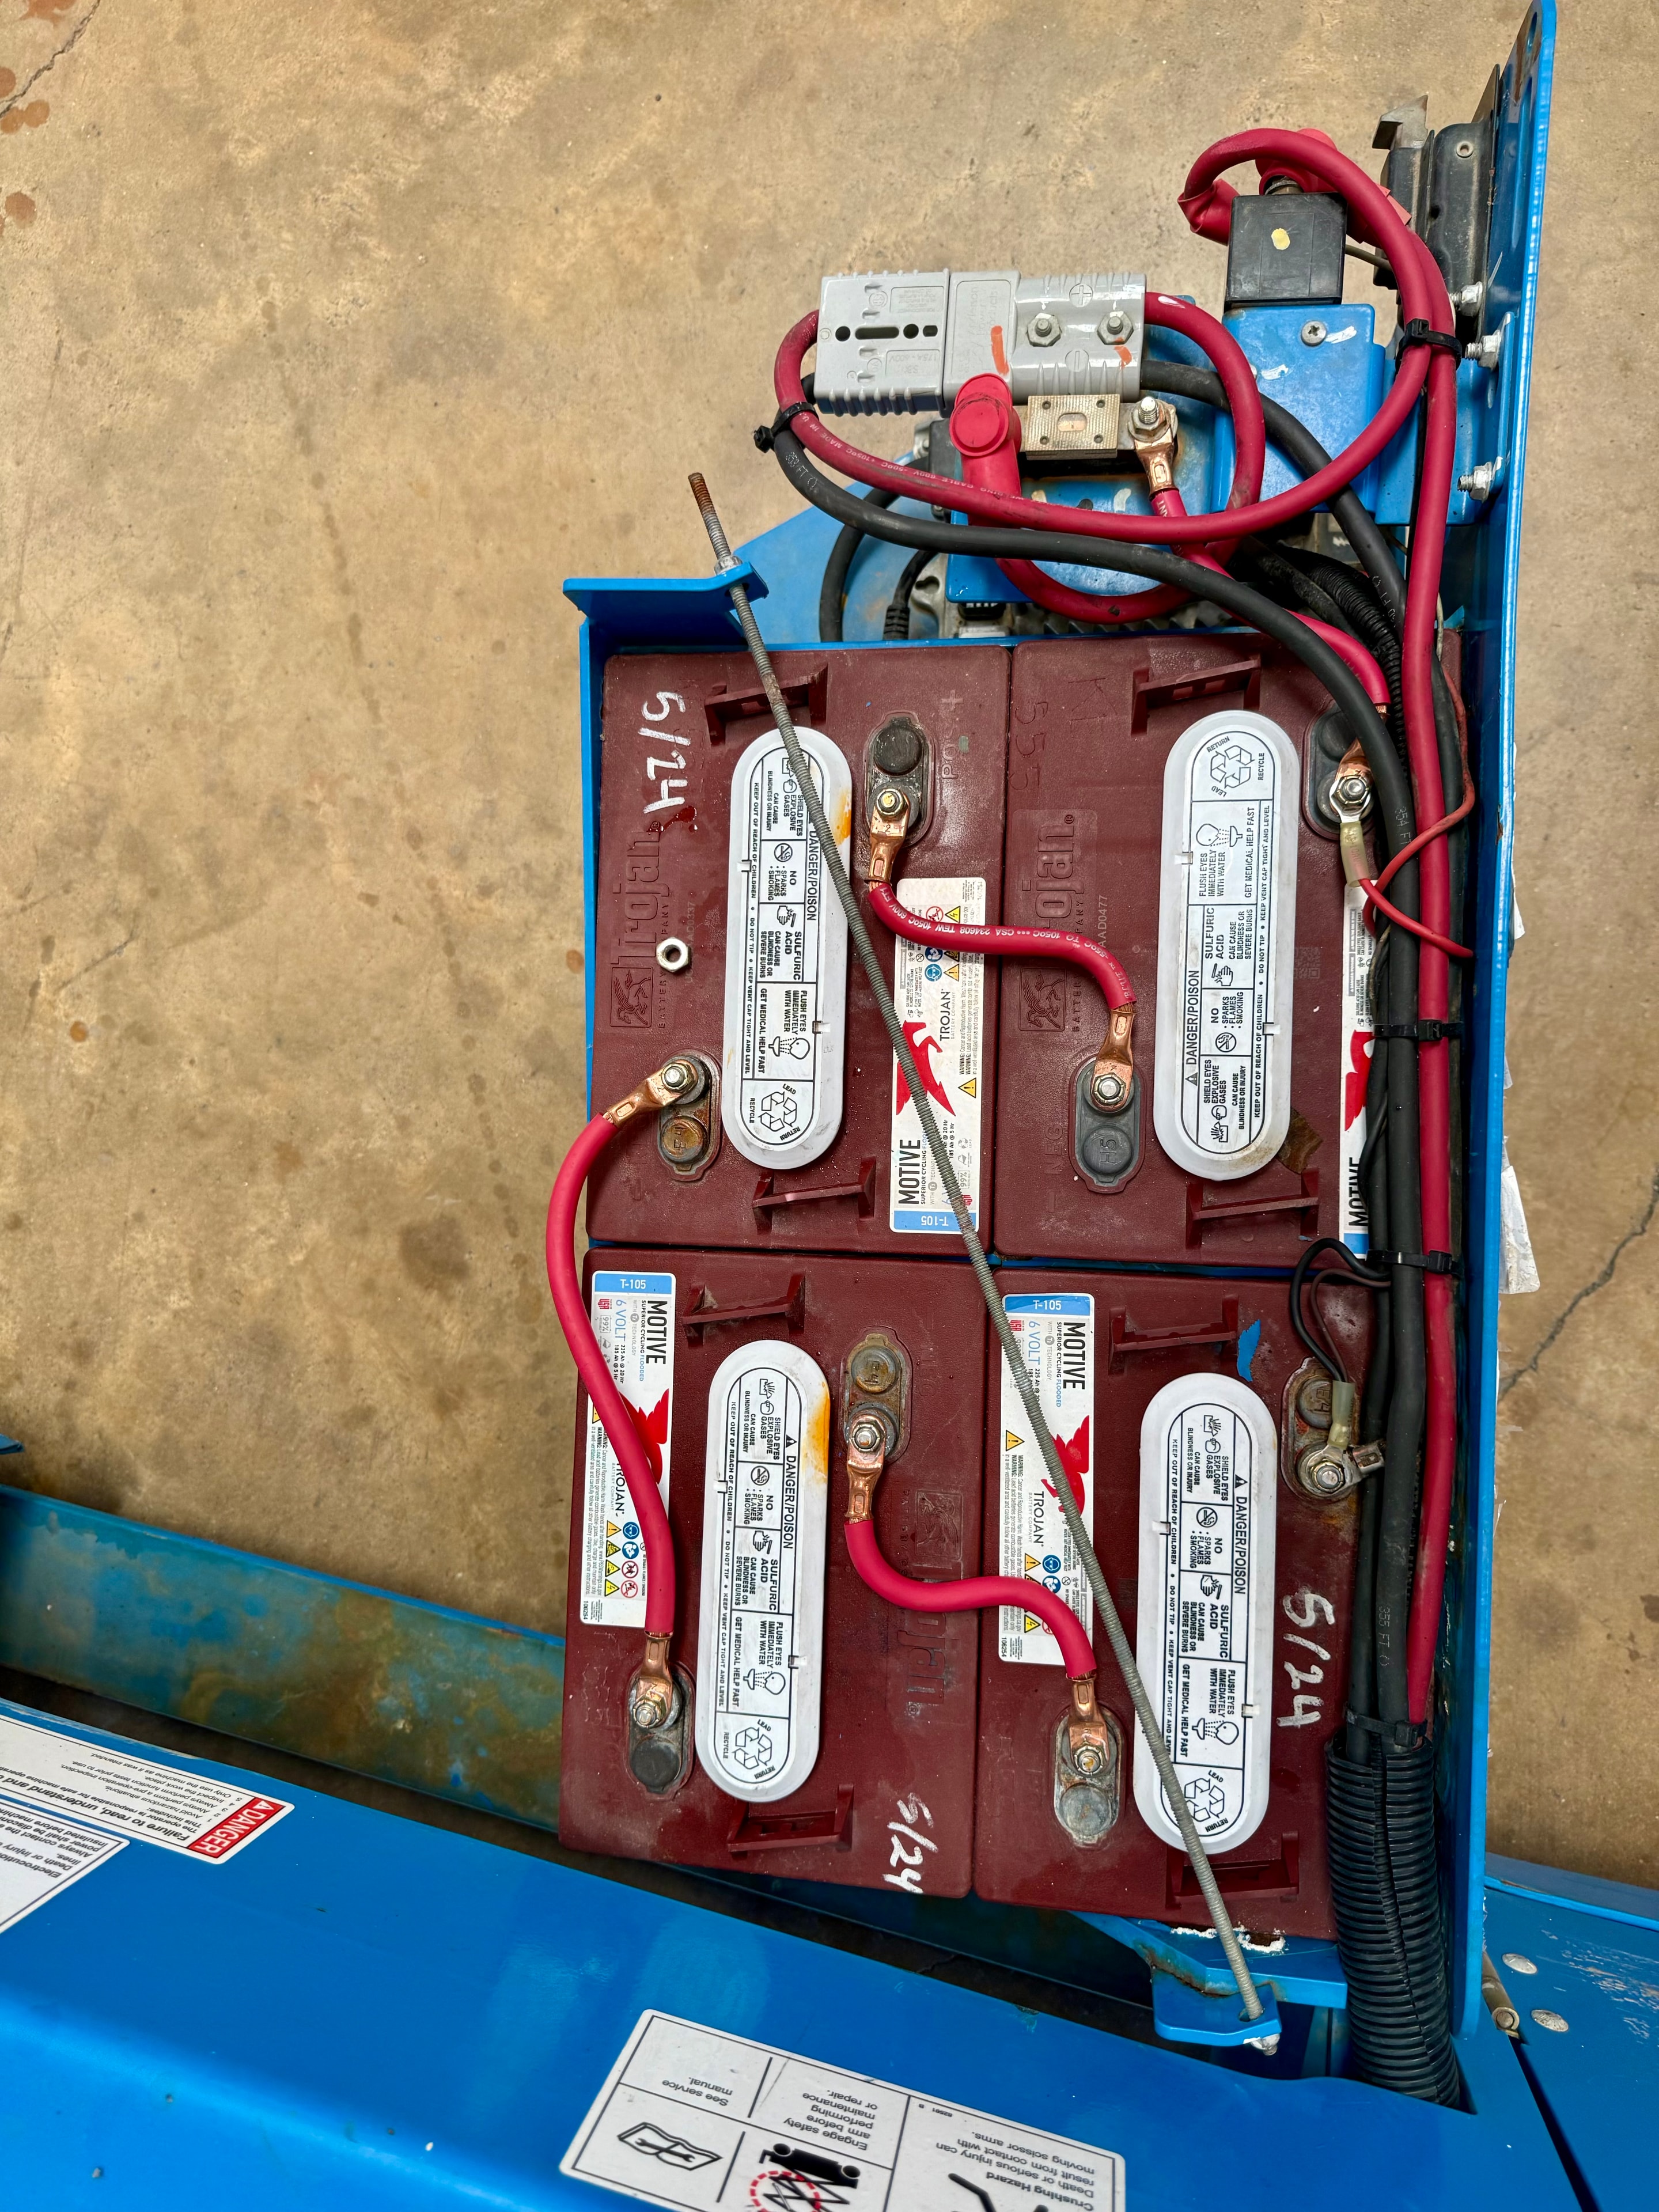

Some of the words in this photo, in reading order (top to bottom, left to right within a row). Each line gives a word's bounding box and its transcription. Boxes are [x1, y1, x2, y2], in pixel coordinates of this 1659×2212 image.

[1205, 734, 1231, 755] RETURN
[638, 691, 692, 815] 5/24
[1211, 785, 1228, 797] LEAD
[797, 794, 805, 817] SHIELD
[790, 871, 797, 885] NO
[807, 830, 820, 920] DANGER/POISON
[1208, 850, 1216, 896] IMMEDIATELY
[934, 923, 956, 934] TEW
[959, 926, 991, 935] 234608
[995, 927, 1015, 937] CSA
[1205, 908, 1214, 959] SULFURIC
[1065, 934, 1080, 944] TO
[793, 934, 801, 980] SULFURIC
[940, 992, 950, 1041] TROJAN
[1186, 969, 1202, 1065] DANGER/POISON
[1256, 1032, 1263, 1041] OF
[1256, 1071, 1261, 1080] OF
[899, 1140, 920, 1204] MOTIVE
[959, 1172, 968, 1187] 99%
[921, 1216, 949, 1226] T-105
[620, 1279, 646, 1289] T-105
[598, 1299, 609, 1309] USA
[1033, 1300, 1061, 1310] T-105
[601, 1316, 610, 1331] 99%
[615, 1309, 626, 1341] VOLT
[646, 1301, 667, 1364] MOTIVE
[1028, 1332, 1040, 1365] VOLT
[1063, 1323, 1085, 1389] MOTIVE
[766, 1495, 773, 1510] NO
[781, 1455, 796, 1550] DANGER/POISON
[1033, 1491, 1044, 1543] TROJAN
[1214, 1538, 1222, 1554] NO
[1232, 1496, 1249, 1596] DANGER/POISON
[770, 1559, 778, 1610] SULFURIC
[1220, 1605, 1229, 1658] SULFURIC
[1277, 1593, 1335, 1727] 5/24
[2, 1778, 29, 1787] and
[26, 1776, 60, 1787] machine
[27, 1786, 98, 1810] understand
[91, 1797, 138, 1813] responsible
[141, 1798, 180, 1812] hazardous
[100, 1808, 131, 1820] read,
[146, 1815, 181, 1827] operator
[147, 1808, 184, 1821] includes:
[179, 1810, 202, 1819] Avoid
[34, 1821, 65, 1833] before
[184, 1820, 201, 1828] This
[195, 1809, 266, 1853] DANGER
[21, 1832, 56, 1845] contact
[45, 1832, 70, 1842] shall
[63, 1831, 108, 1847] insulated
[147, 1824, 190, 1840] Failure
[3, 1844, 32, 1857] injury
[58, 1844, 92, 1857] Always
[70, 1841, 101, 1851] power
[44, 1858, 73, 1870] Death
[57, 1854, 81, 1865] lines.
[662, 2081, 703, 2096] service
[689, 2077, 733, 2095] manual.
[706, 2094, 728, 2106] See
[827, 2090, 862, 2105] repair.
[803, 2093, 875, 2119] maintenance
[807, 2115, 843, 2132] before
[811, 2105, 873, 2129] performing
[783, 2118, 819, 2133] safety
[823, 2131, 868, 2150] Engage
[848, 2128, 870, 2139] arm
[972, 2132, 1003, 2146] arms.
[936, 2143, 957, 2153] can
[957, 2139, 980, 2150] with
[1007, 2144, 1048, 2160] scissor
[960, 2150, 992, 2166] injury
[984, 2147, 1027, 2164] contact
[996, 2162, 1039, 2179] serious
[1031, 2162, 1057, 2176] from
[1052, 2156, 1094, 2174] moving
[986, 2172, 1031, 2192] Hazard
[1062, 2171, 1094, 2186] result
[1058, 2181, 1093, 2198] Death
[1034, 2186, 1093, 2211] Crushing
